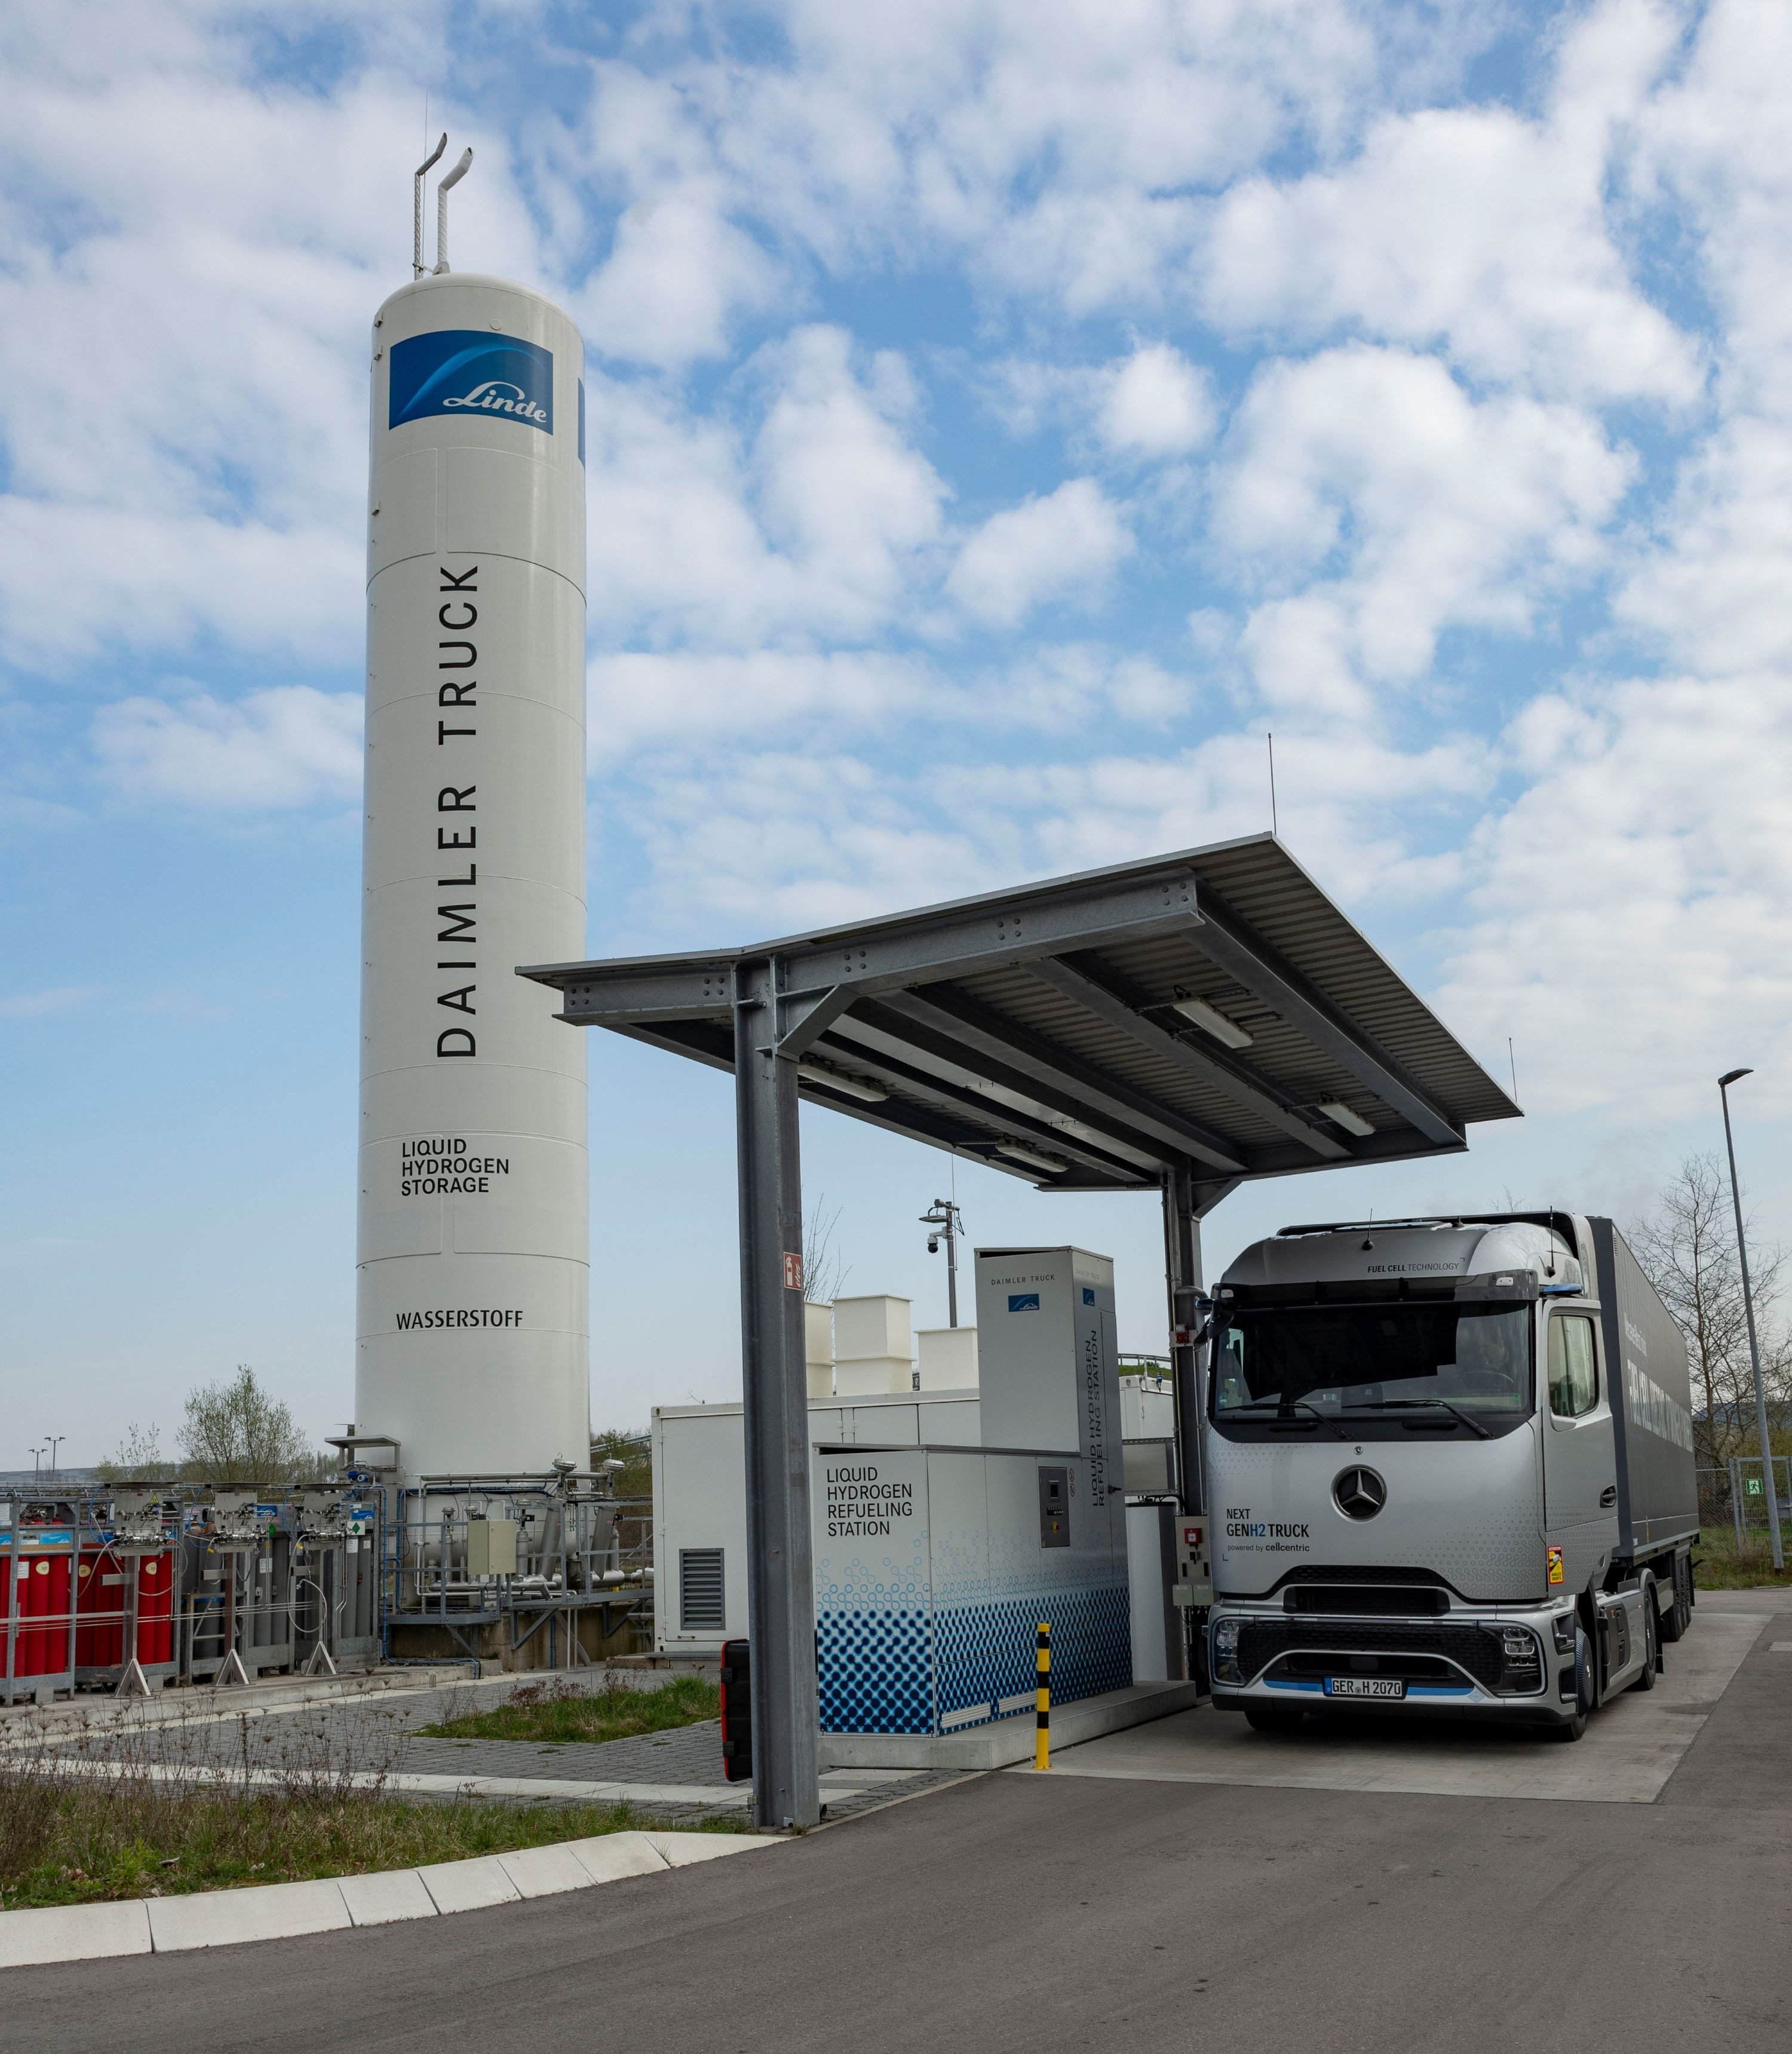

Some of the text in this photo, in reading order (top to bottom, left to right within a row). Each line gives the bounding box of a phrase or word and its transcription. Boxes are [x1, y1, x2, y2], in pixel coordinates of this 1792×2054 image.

[443, 381, 547, 423] Linde
[437, 566, 478, 1057] DAIMLER TRUCK
[402, 1138, 467, 1158] LIQUID
[402, 1157, 510, 1177] HYDROGEN
[401, 1177, 490, 1196] STORAGE
[1407, 1263, 1459, 1271] TECHNOLOGY
[991, 1274, 1055, 1285] DAIMLER TRUCK
[397, 1310, 523, 1330] WASSERSTOFF
[1085, 1341, 1096, 1438] HYDROGEN
[1091, 1330, 1104, 1506] REFUELING STATION
[827, 1467, 877, 1483] LIQUID
[827, 1483, 912, 1501] HYDROGEN
[828, 1501, 913, 1519] REFUELING
[1226, 1509, 1251, 1519] NEXT
[828, 1520, 890, 1537] STATION
[1226, 1523, 1310, 1537] GENH2 TRUCK
[1265, 1542, 1310, 1552] cellcentric
[1332, 1680, 1401, 1694] GER H 2070
